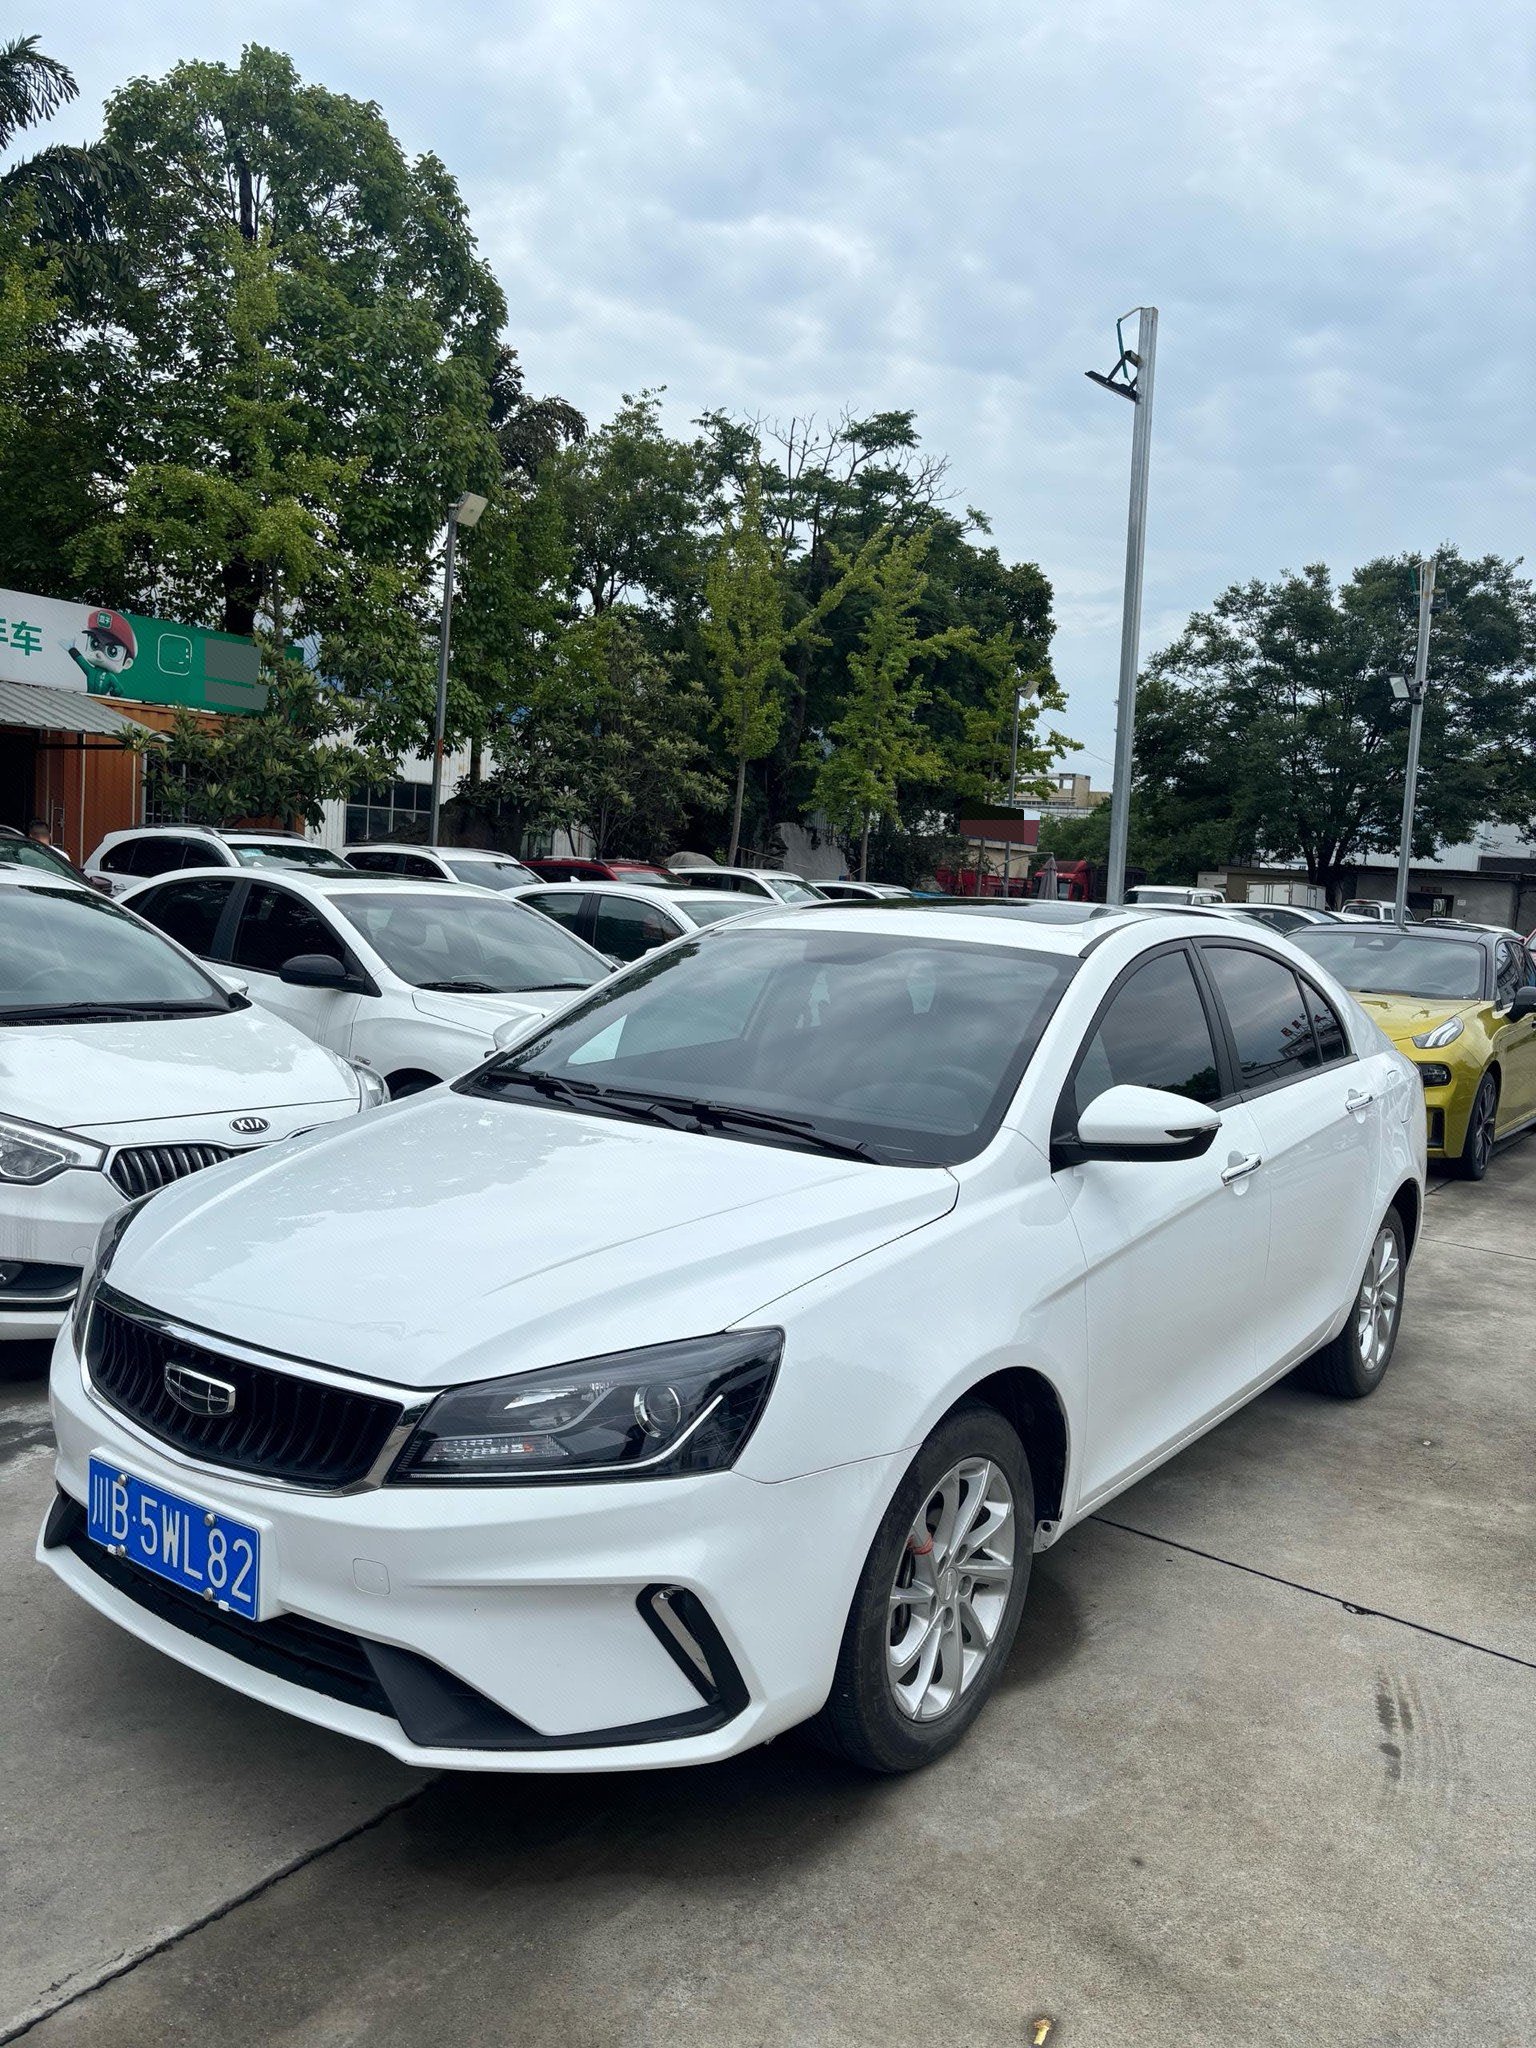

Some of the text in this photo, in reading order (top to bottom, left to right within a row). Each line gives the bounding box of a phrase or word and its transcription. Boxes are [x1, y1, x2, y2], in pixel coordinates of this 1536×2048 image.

[0, 618, 43, 656] 车
[235, 1118, 266, 1131] KIA
[92, 1474, 253, 1603] 川B·5WL82
